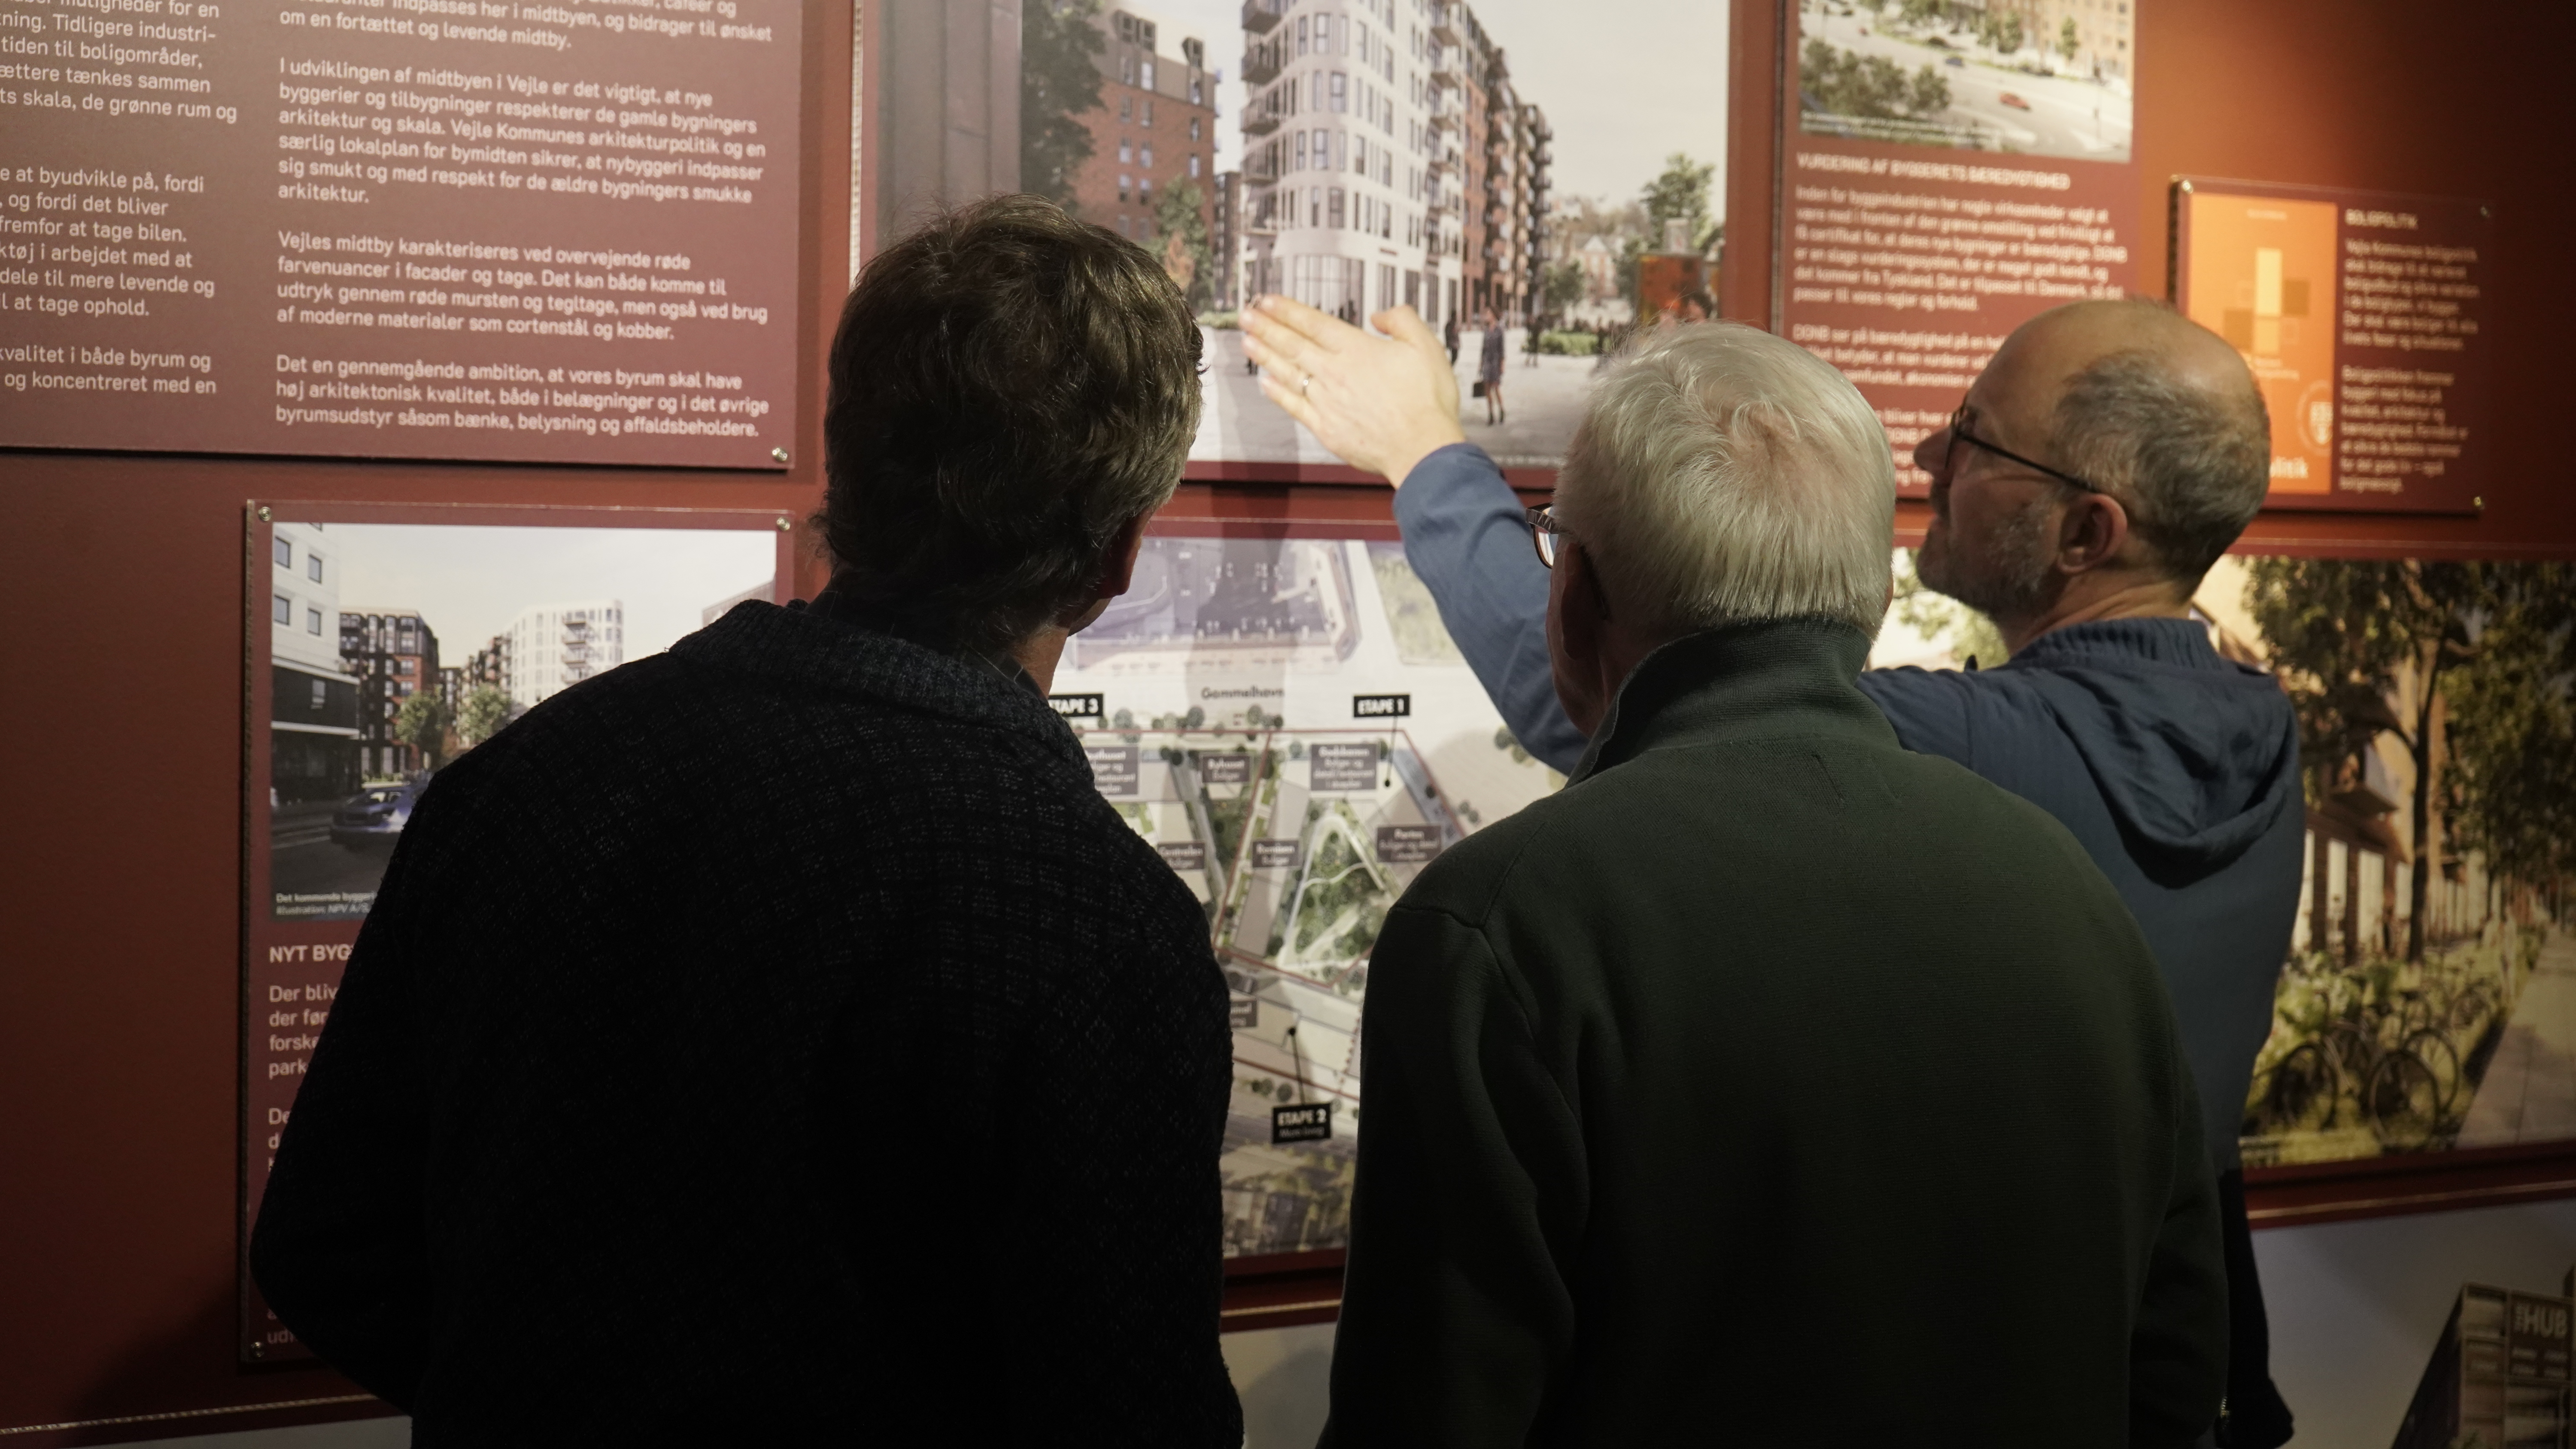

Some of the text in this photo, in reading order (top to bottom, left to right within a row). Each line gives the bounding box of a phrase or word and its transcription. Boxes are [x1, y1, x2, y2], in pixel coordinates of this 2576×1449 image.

[169, 0, 192, 15] for
[198, 4, 219, 18] en
[0, 11, 216, 42] ning. Tidligere industri-
[280, 11, 571, 51] om en fortættet og levende midtby.
[1, 36, 202, 69] tiden til boligområder,
[66, 67, 132, 87] tænkes
[138, 76, 210, 92] sammen
[280, 58, 712, 109] I udviklingen af midtbyen i Vejle er det vigtigt, at nye
[24, 89, 76, 110] skala,
[82, 94, 103, 110] de
[110, 99, 172, 115] grønne
[178, 103, 211, 118] rum
[216, 106, 237, 124] og
[280, 82, 756, 135] byggerier og tilbygninger respekterer de gamle bygningers
[279, 109, 766, 160] arkitektur og skala. Vejle Kommunes arkitekturpolitik og en
[279, 134, 763, 180] særlig lokalplan for bymidten sikrer, at nybyggeri indpasser
[16, 167, 33, 182] at
[40, 167, 127, 188] byudvikle
[133, 172, 158, 192] på,
[165, 174, 204, 192] fordi
[279, 157, 752, 203] sig smukt og med respekt for de ældre bygningers smukke
[279, 183, 369, 203] arkitektur.
[9, 192, 168, 215] og fordi det bliver
[70, 221, 86, 236] at
[93, 222, 133, 243] tage
[138, 224, 186, 242] bilen.
[279, 231, 690, 270] Vejles midtby karakteriseres ved overvejende røde
[45, 270, 64, 286] til
[70, 274, 114, 289] mere
[120, 273, 188, 292] levende
[194, 281, 214, 298] og
[277, 306, 674, 341] af moderne materialer som cortenstål og kobber.
[277, 355, 742, 389] Det en gennemgående ambition, at vores byrum skal have
[276, 405, 758, 437] byrumsudstyr såsom bænke, belysning og affaldsbeholdere.
[1088, 697, 1099, 714] 3
[1358, 698, 1404, 715] ETAPE 1
[269, 944, 352, 963] NYT BYG
[269, 985, 301, 1002] Der
[269, 1011, 297, 1027] der
[1277, 1108, 1327, 1126] ETAPE 2
